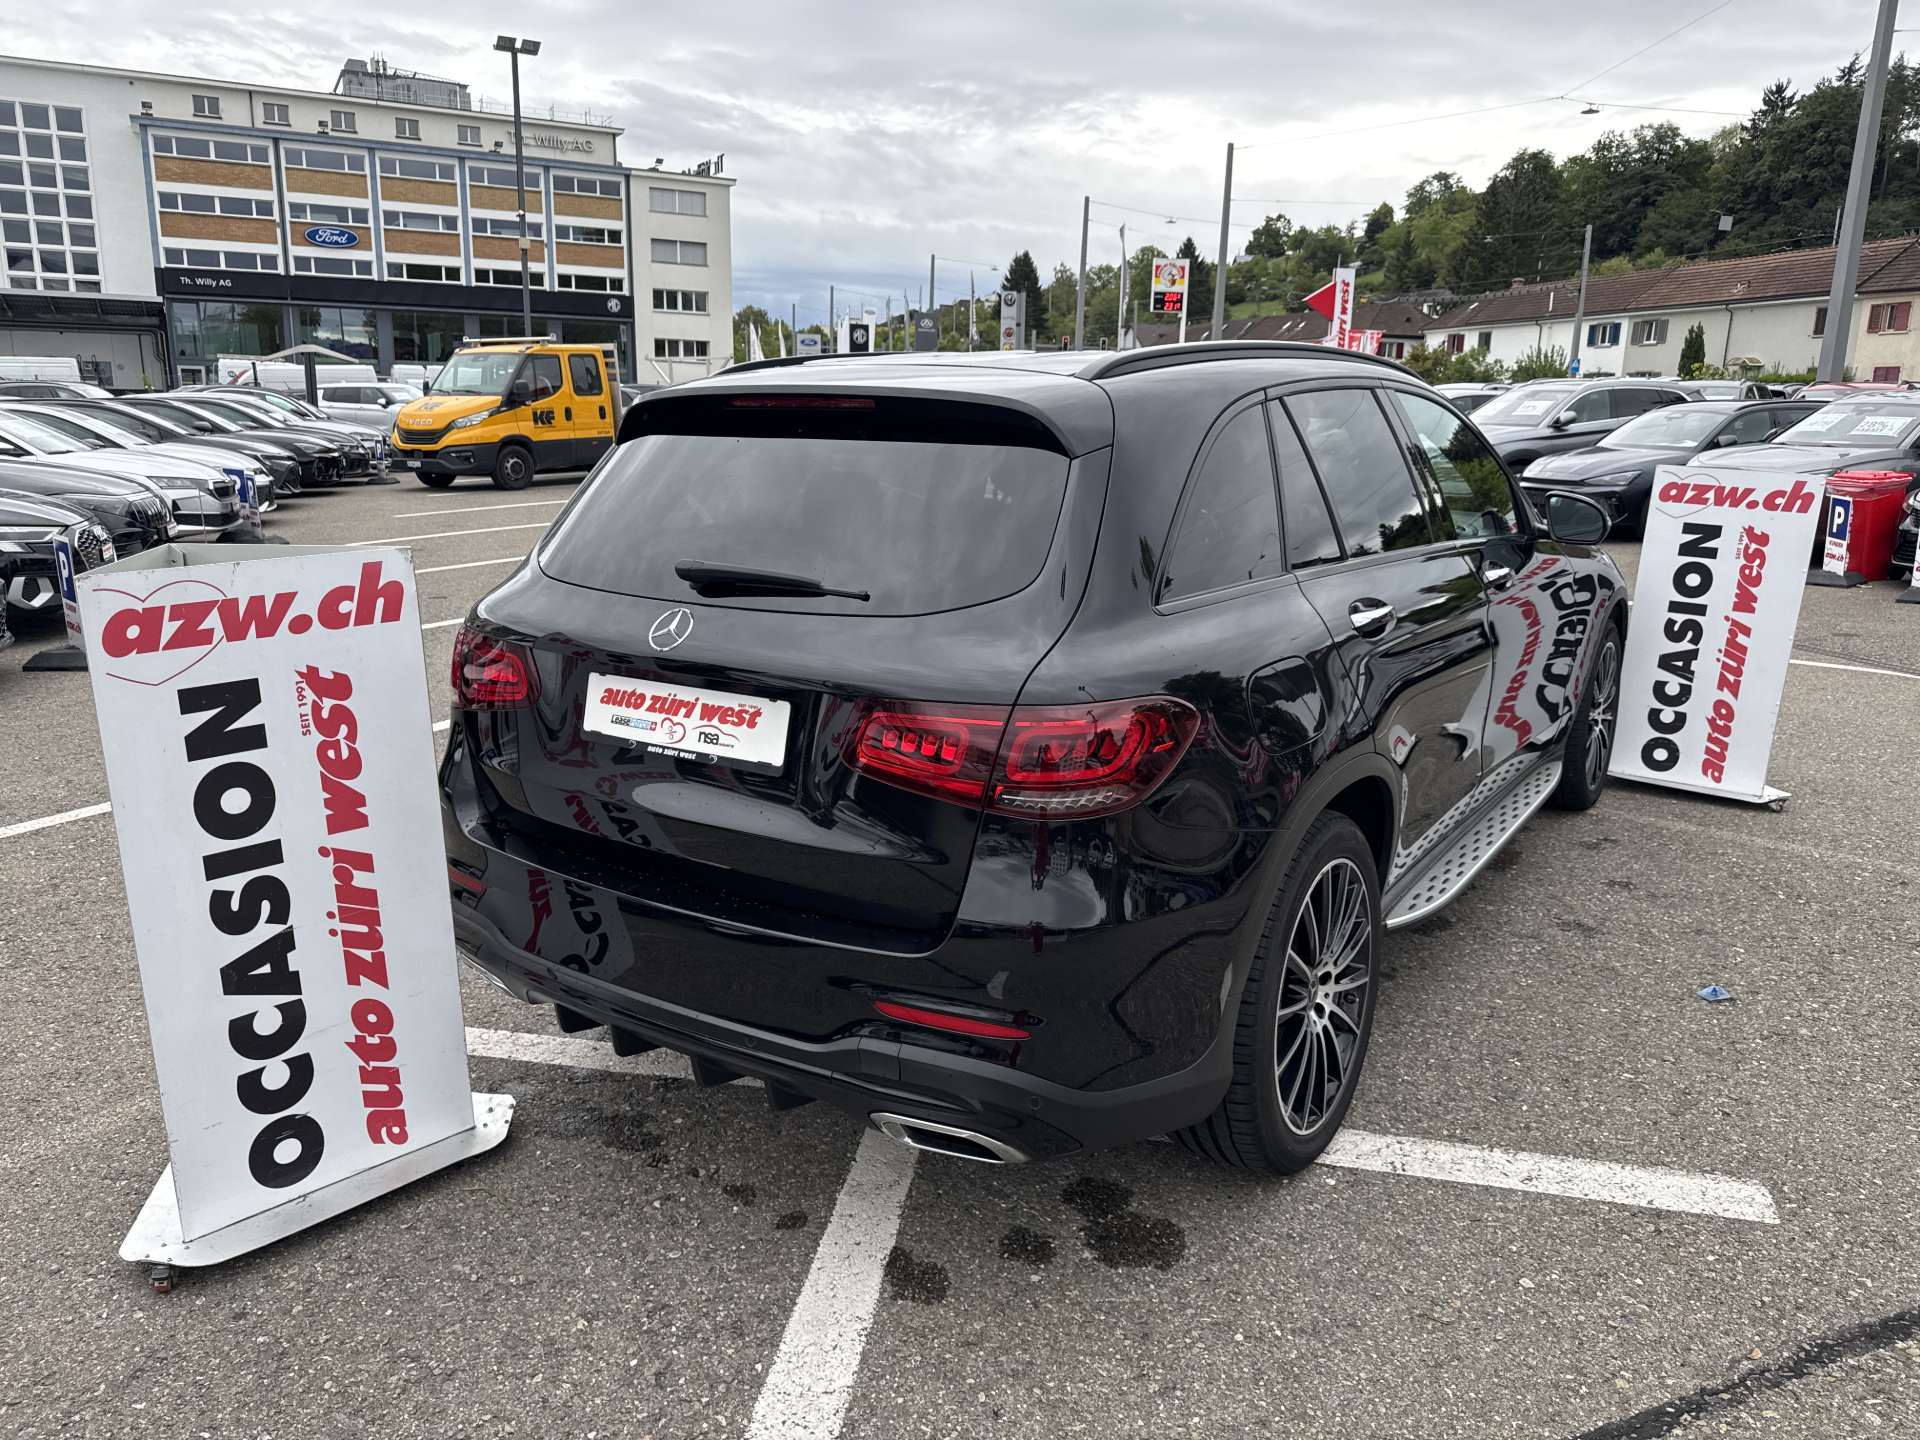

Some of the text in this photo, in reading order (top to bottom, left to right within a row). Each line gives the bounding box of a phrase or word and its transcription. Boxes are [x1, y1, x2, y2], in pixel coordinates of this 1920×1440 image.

[535, 133, 569, 153] Willy
[572, 137, 594, 153] AG
[315, 229, 349, 244] Ford
[180, 276, 232, 288] Th. Willy AG
[1658, 480, 1816, 514] azw.ch
[1832, 505, 1845, 533] P
[59, 552, 69, 591] P
[101, 560, 405, 658] azw.ch
[1640, 522, 1723, 772] OCCASION
[1701, 525, 1770, 784] auto züri west
[295, 680, 311, 736] SEIT 1991
[600, 688, 763, 729] auto züri west
[647, 745, 663, 754] auto
[679, 751, 697, 760] west
[698, 731, 719, 746] nsa
[294, 664, 410, 1146] auto züri west
[176, 677, 325, 1189] OCCASION
